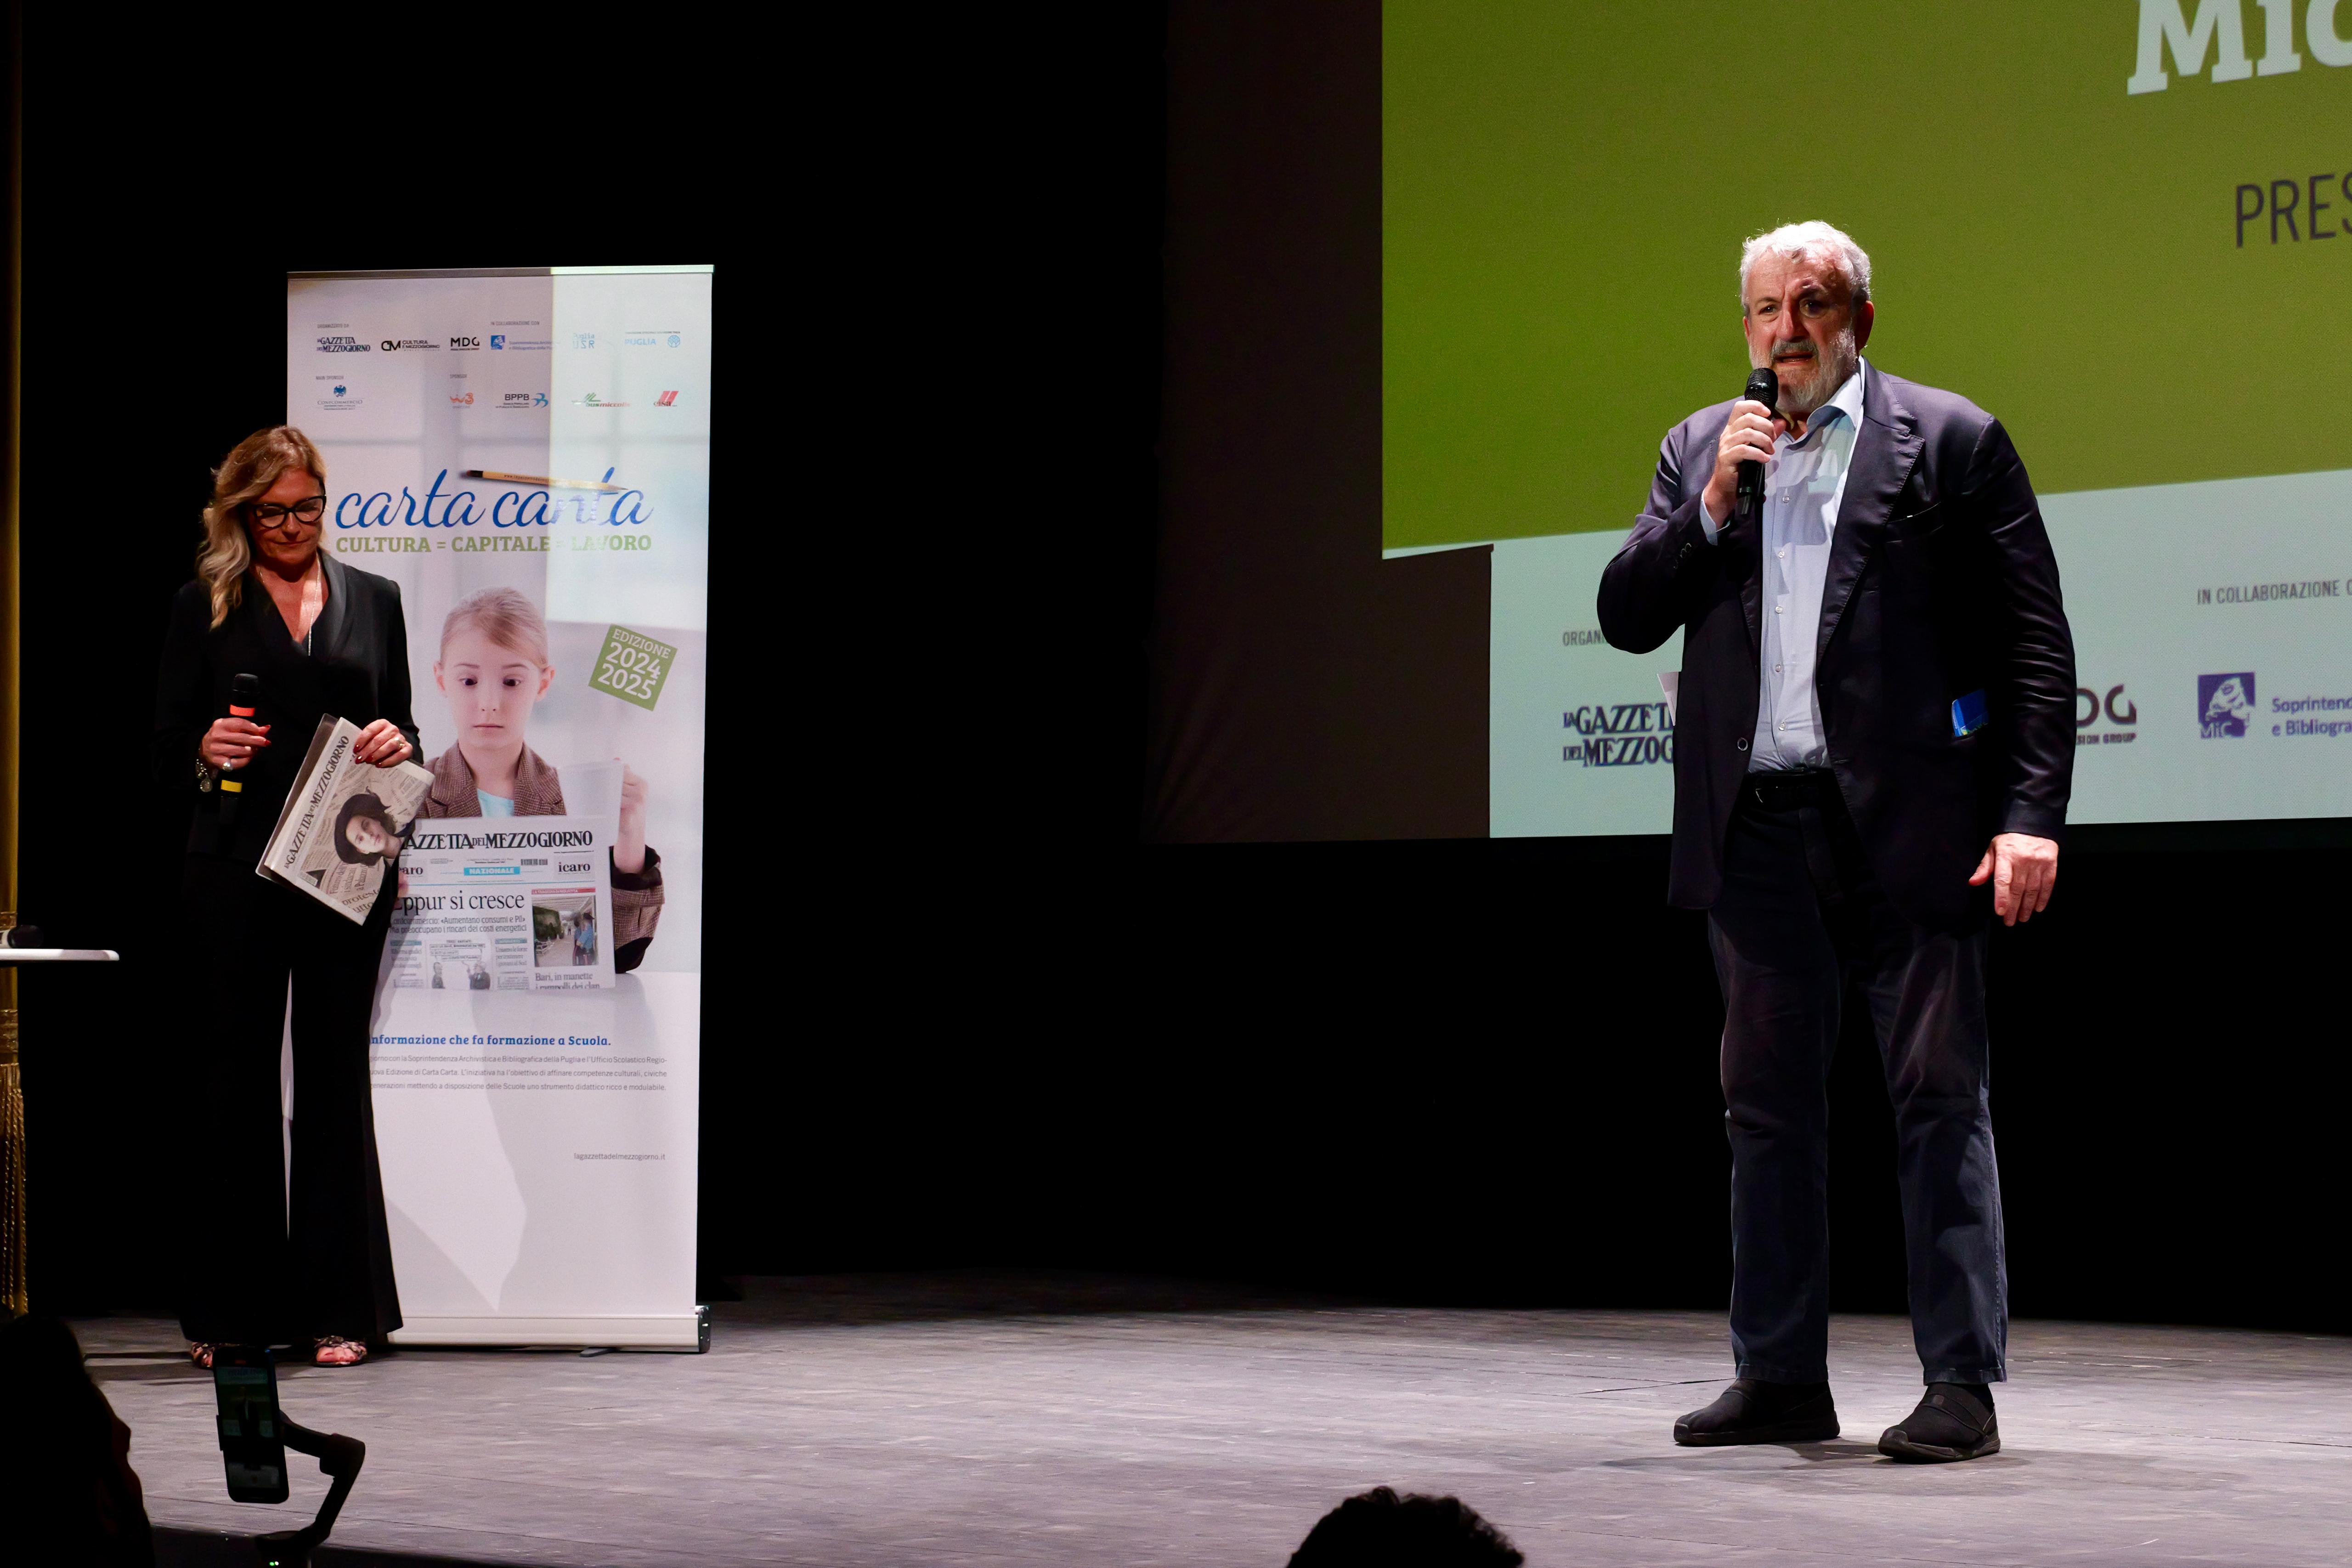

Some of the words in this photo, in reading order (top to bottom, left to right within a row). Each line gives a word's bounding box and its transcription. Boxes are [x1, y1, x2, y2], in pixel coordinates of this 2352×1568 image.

[321, 337, 356, 345] GAZZETTA
[450, 337, 480, 347] MDG
[335, 469, 486, 528] carta
[492, 466, 654, 528] canta
[336, 537, 430, 553] CULTURA
[452, 536, 550, 552] CAPITALE
[571, 534, 652, 551] LAVORO
[2198, 588, 2211, 605] IN
[2216, 580, 2340, 605] COLLABORAZIONE
[612, 628, 671, 659] EDIZIONE
[1563, 629, 1605, 646] ORGAN
[605, 642, 661, 679] 2024
[598, 662, 656, 699] 2025
[2076, 683, 2137, 728] DG
[2272, 694, 2352, 714] Soprintend
[1576, 702, 1674, 735] GAZZET
[2272, 725, 2281, 736] e
[2286, 718, 2352, 738] Bibliogra
[1583, 735, 1674, 768] MEZZOG
[286, 813, 314, 865] GAZZETTA
[310, 736, 349, 808] MEZZOGIORNO
[402, 834, 474, 850] AZZETTA
[472, 838, 486, 846] DEL
[486, 831, 593, 849] MEZZOGIORNO
[558, 861, 591, 872] icaro
[394, 895, 446, 916] ppur
[450, 890, 464, 910] si
[469, 894, 525, 910] cresce
[401, 925, 442, 934] preoccupano
[496, 923, 527, 933] energetici
[535, 973, 552, 982] Bari,
[371, 1035, 447, 1045] nformazione
[449, 1035, 469, 1045] che
[472, 1035, 484, 1045] fa
[487, 1035, 555, 1045] formazione
[568, 1036, 611, 1046] Scuola.
[408, 1055, 458, 1063] Soprintendenza
[560, 1056, 582, 1064] Puglia
[646, 1056, 667, 1064] Regio-
[574, 1153, 666, 1161] lagazzettadelmezzogiorno.it
